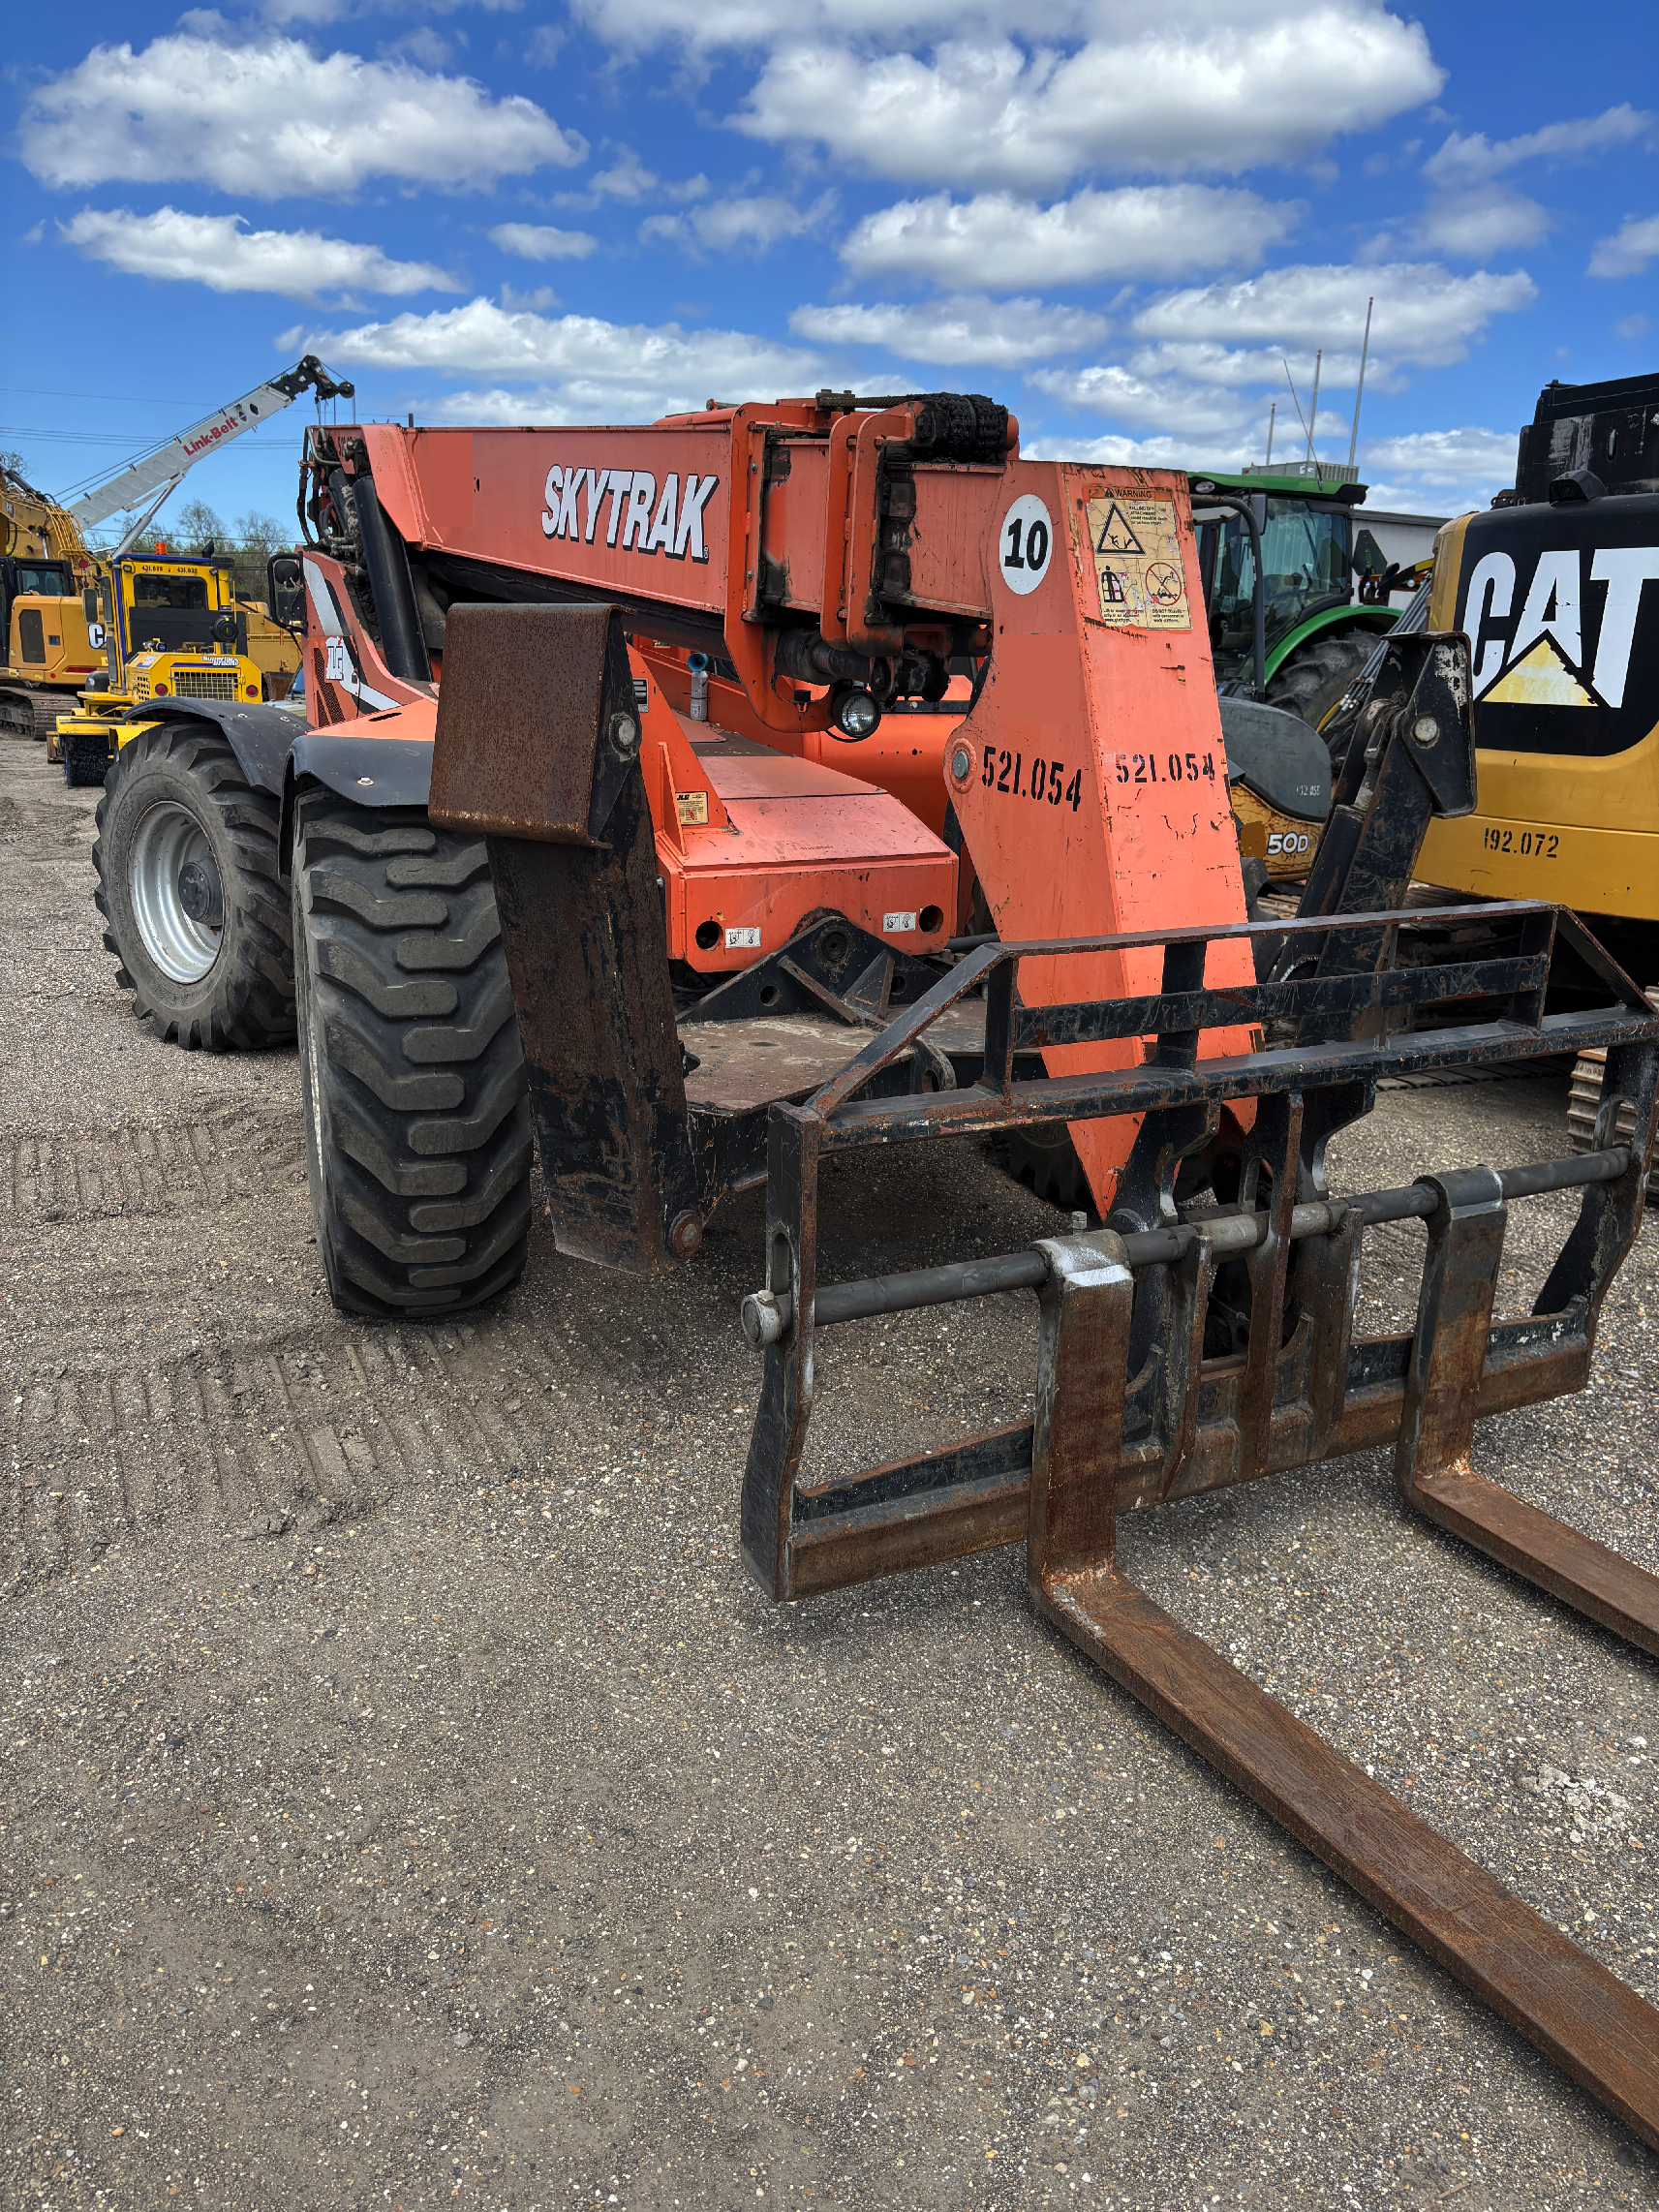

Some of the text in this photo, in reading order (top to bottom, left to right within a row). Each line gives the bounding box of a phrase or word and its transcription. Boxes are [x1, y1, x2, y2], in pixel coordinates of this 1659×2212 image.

[1116, 490, 1152, 499] WARNING
[541, 464, 720, 565] SKYTRAK
[1004, 518, 1049, 571] 10
[88, 624, 108, 649] C
[1462, 547, 1659, 708] CAT
[982, 746, 1082, 812] 521.054
[1116, 753, 1215, 783] 521.054
[1267, 831, 1308, 855] 50D
[1484, 827, 1559, 858] 192.072
